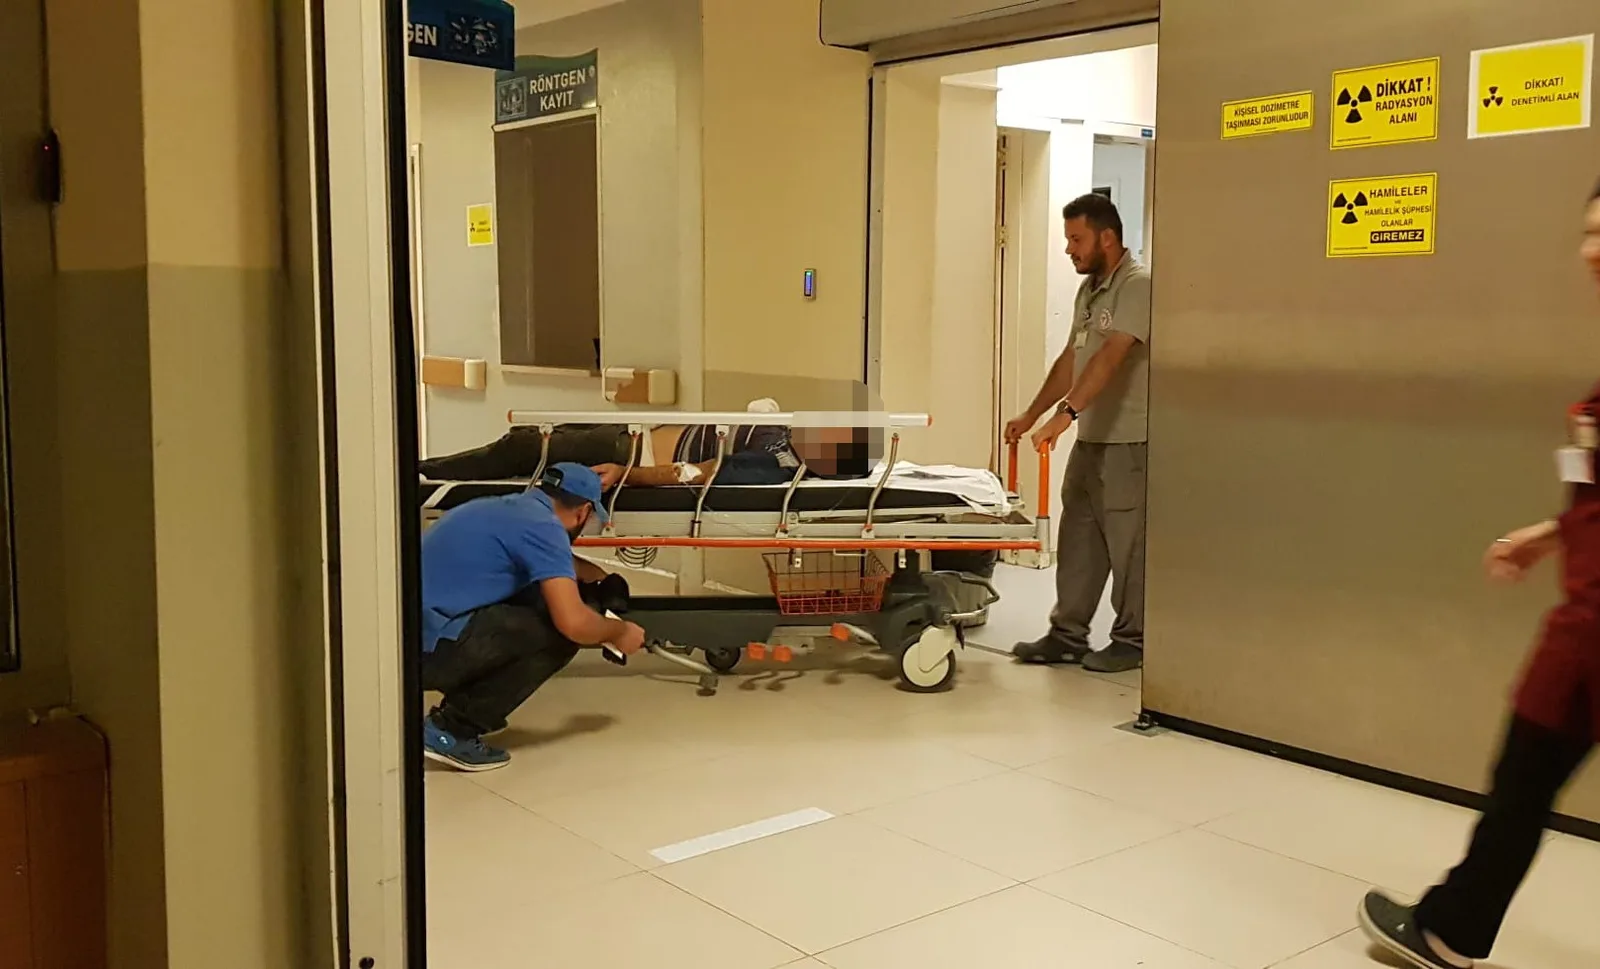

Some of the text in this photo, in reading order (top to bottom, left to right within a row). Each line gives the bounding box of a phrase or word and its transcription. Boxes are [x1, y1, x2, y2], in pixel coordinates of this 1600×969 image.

[529, 67, 586, 95] RÖNTGEN
[1376, 78, 1424, 97] DİKKAT
[1524, 77, 1564, 90] DİKKAT!
[539, 90, 575, 111] KAYIT
[1375, 95, 1433, 111] RADYASYON
[1511, 92, 1579, 106] DENETİMLİ ALAN
[1263, 111, 1309, 125] ZORUNLUDUR
[1389, 112, 1417, 124] ALANI
[1369, 185, 1427, 198] HAMİLELER
[1381, 218, 1413, 227] OLANLAR
